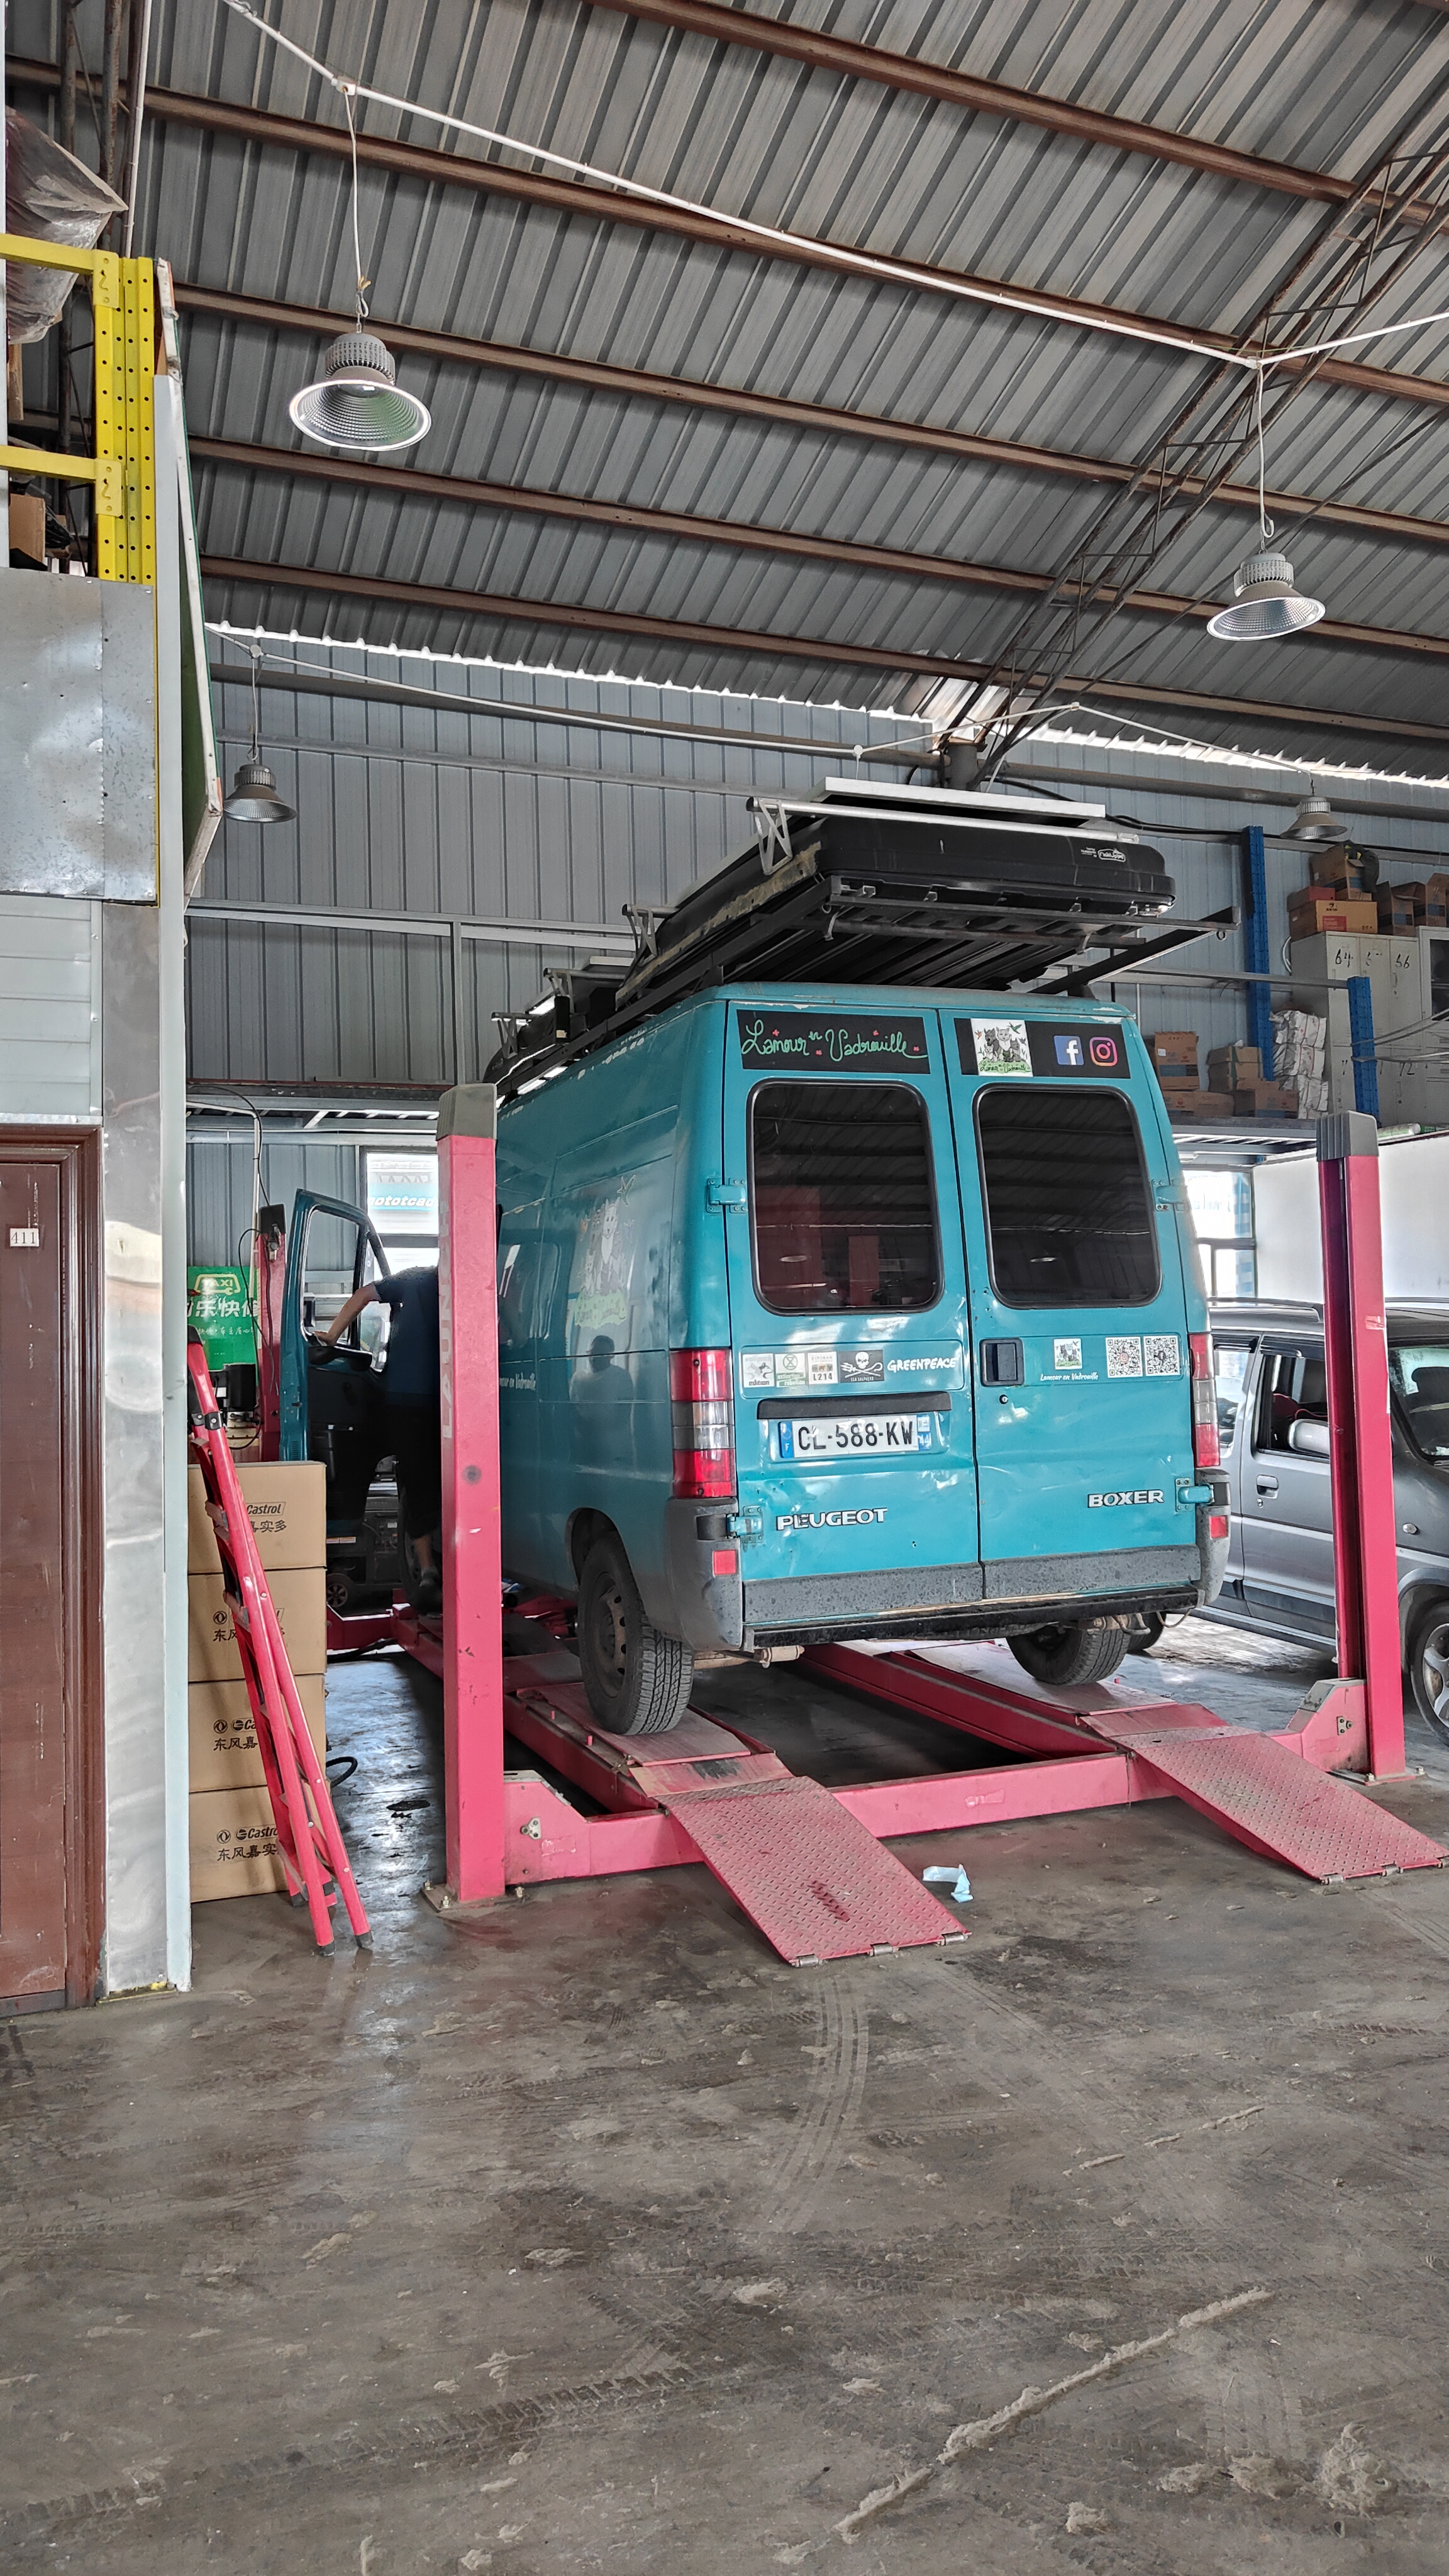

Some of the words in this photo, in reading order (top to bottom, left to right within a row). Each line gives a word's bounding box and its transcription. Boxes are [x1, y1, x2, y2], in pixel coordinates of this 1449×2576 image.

[825, 1029, 928, 1062] Vadrouille
[11, 1231, 35, 1244] 411
[887, 1357, 957, 1373] GREENPEACE
[1072, 1372, 1099, 1380] Vadrouille
[798, 1421, 913, 1450] CL-588-KW
[1087, 1489, 1165, 1508] BOXER
[247, 1504, 281, 1514] Castrol
[776, 1507, 888, 1531] PEUGEOT
[213, 1736, 258, 1751] 东风嘉
[248, 1827, 277, 1838] Castr
[217, 1843, 277, 1861] 东风嘉实
